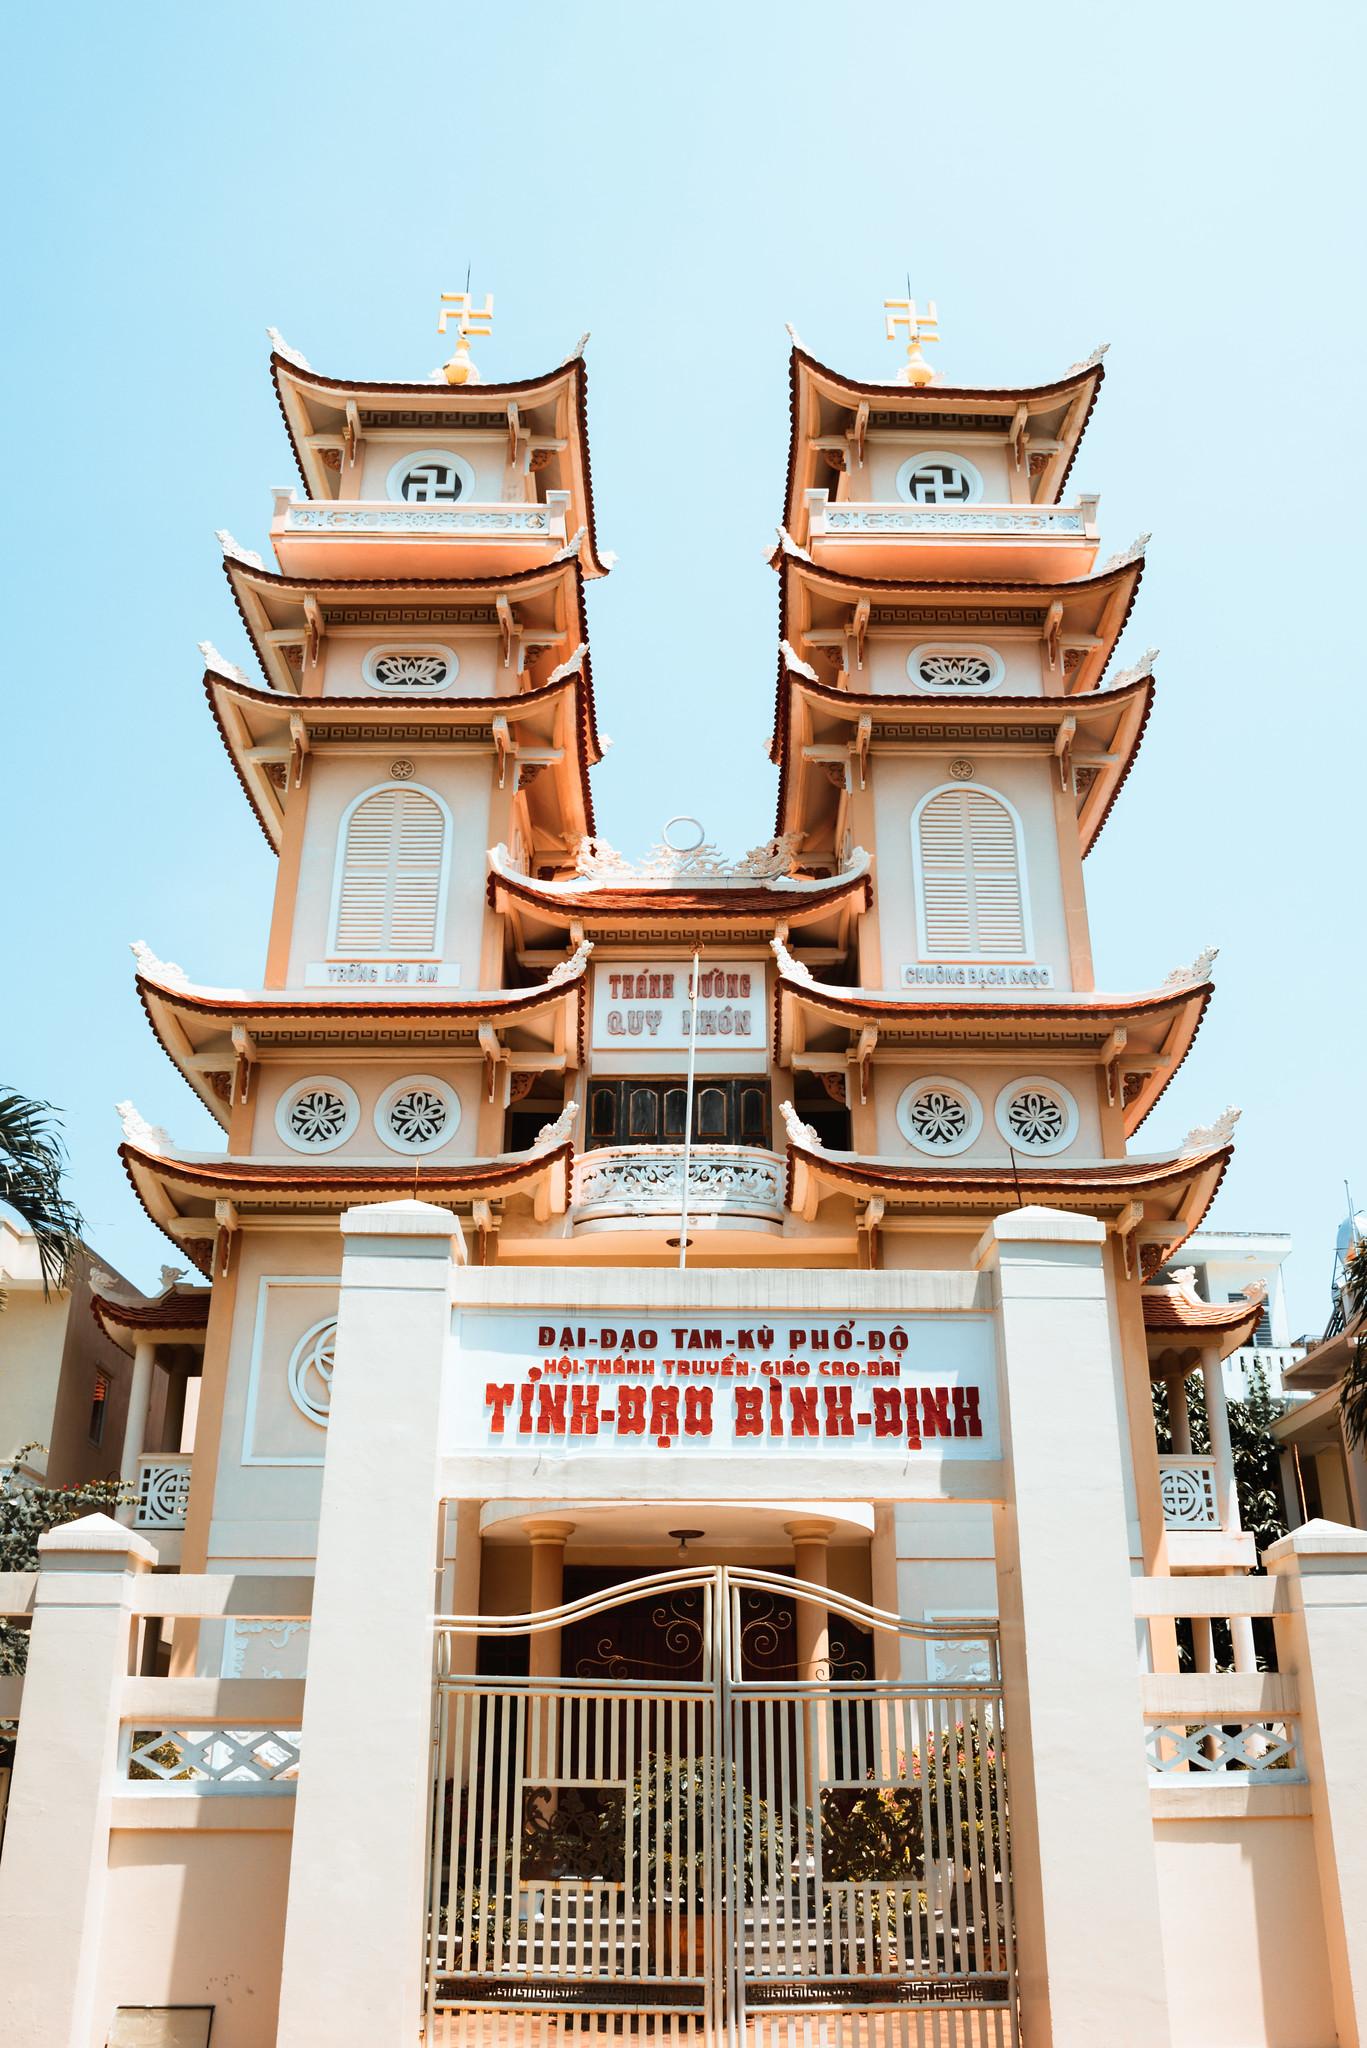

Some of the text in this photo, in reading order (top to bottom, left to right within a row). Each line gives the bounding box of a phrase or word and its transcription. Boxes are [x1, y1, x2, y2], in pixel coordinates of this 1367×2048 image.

[609, 969, 675, 999] THÁNH
[905, 963, 965, 984] CHUÔNG
[607, 1010, 663, 1036] QUY
[538, 1320, 909, 1358] ĐẠI-ĐẠO TAM-KỲ PHỔ-ĐỘ
[543, 1354, 655, 1380] HỘI-THÁNH
[818, 1355, 901, 1377] CAO-ĐÀI
[485, 1366, 983, 1450] TỈNH-ĐẠO BÌNH-ĐỊNH
